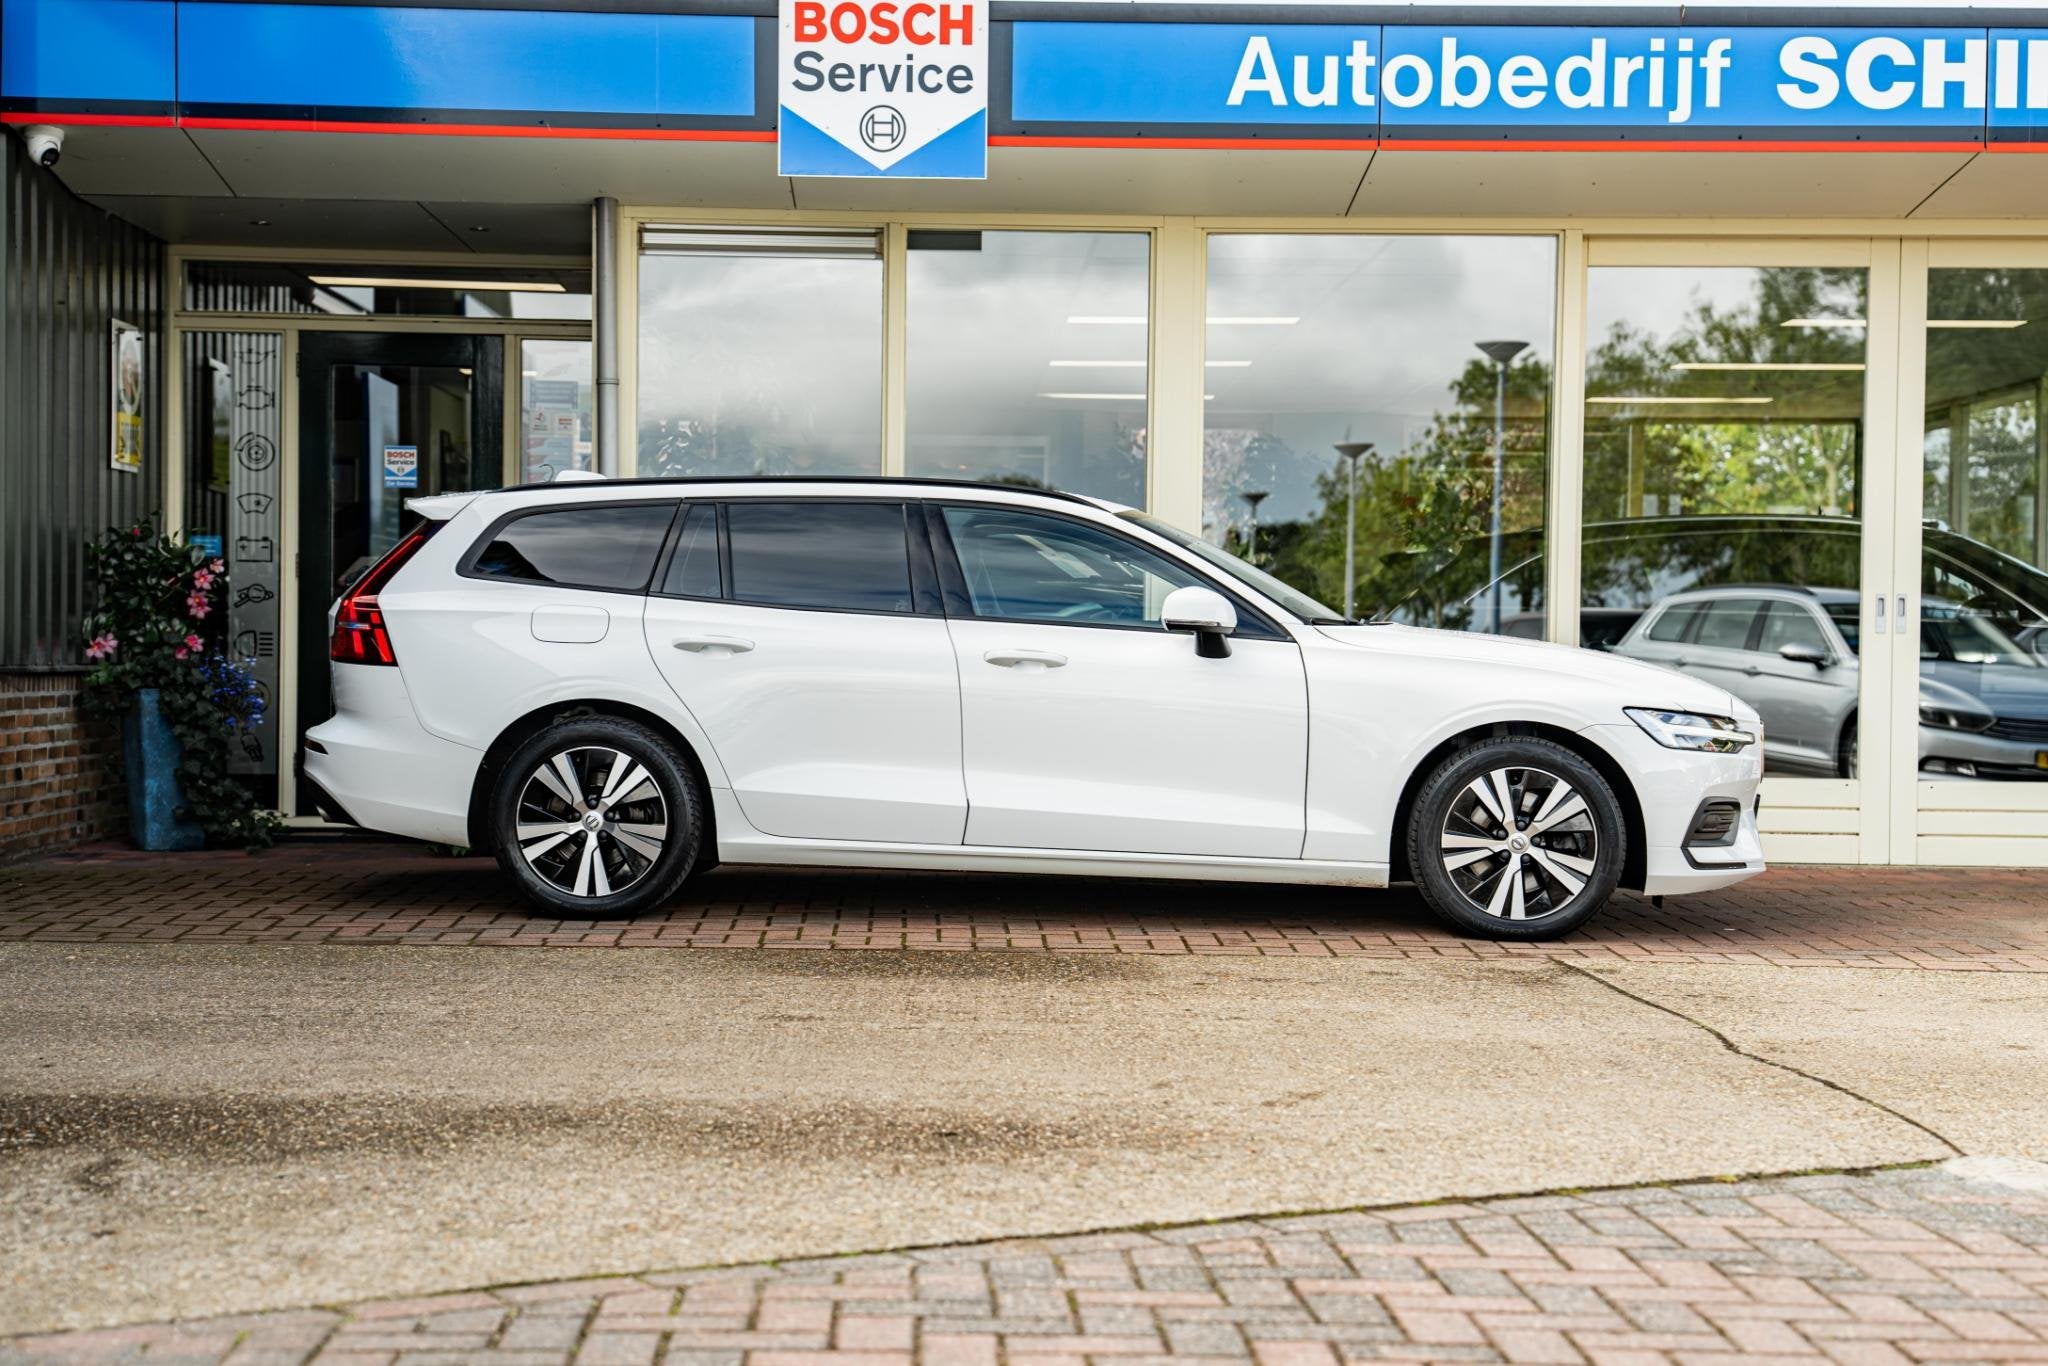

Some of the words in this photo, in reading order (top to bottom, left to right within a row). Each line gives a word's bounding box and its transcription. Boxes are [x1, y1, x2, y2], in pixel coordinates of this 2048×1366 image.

[794, 2, 973, 45] BOSCH
[792, 51, 973, 94] Service
[1226, 36, 1732, 123] Autobedrijf
